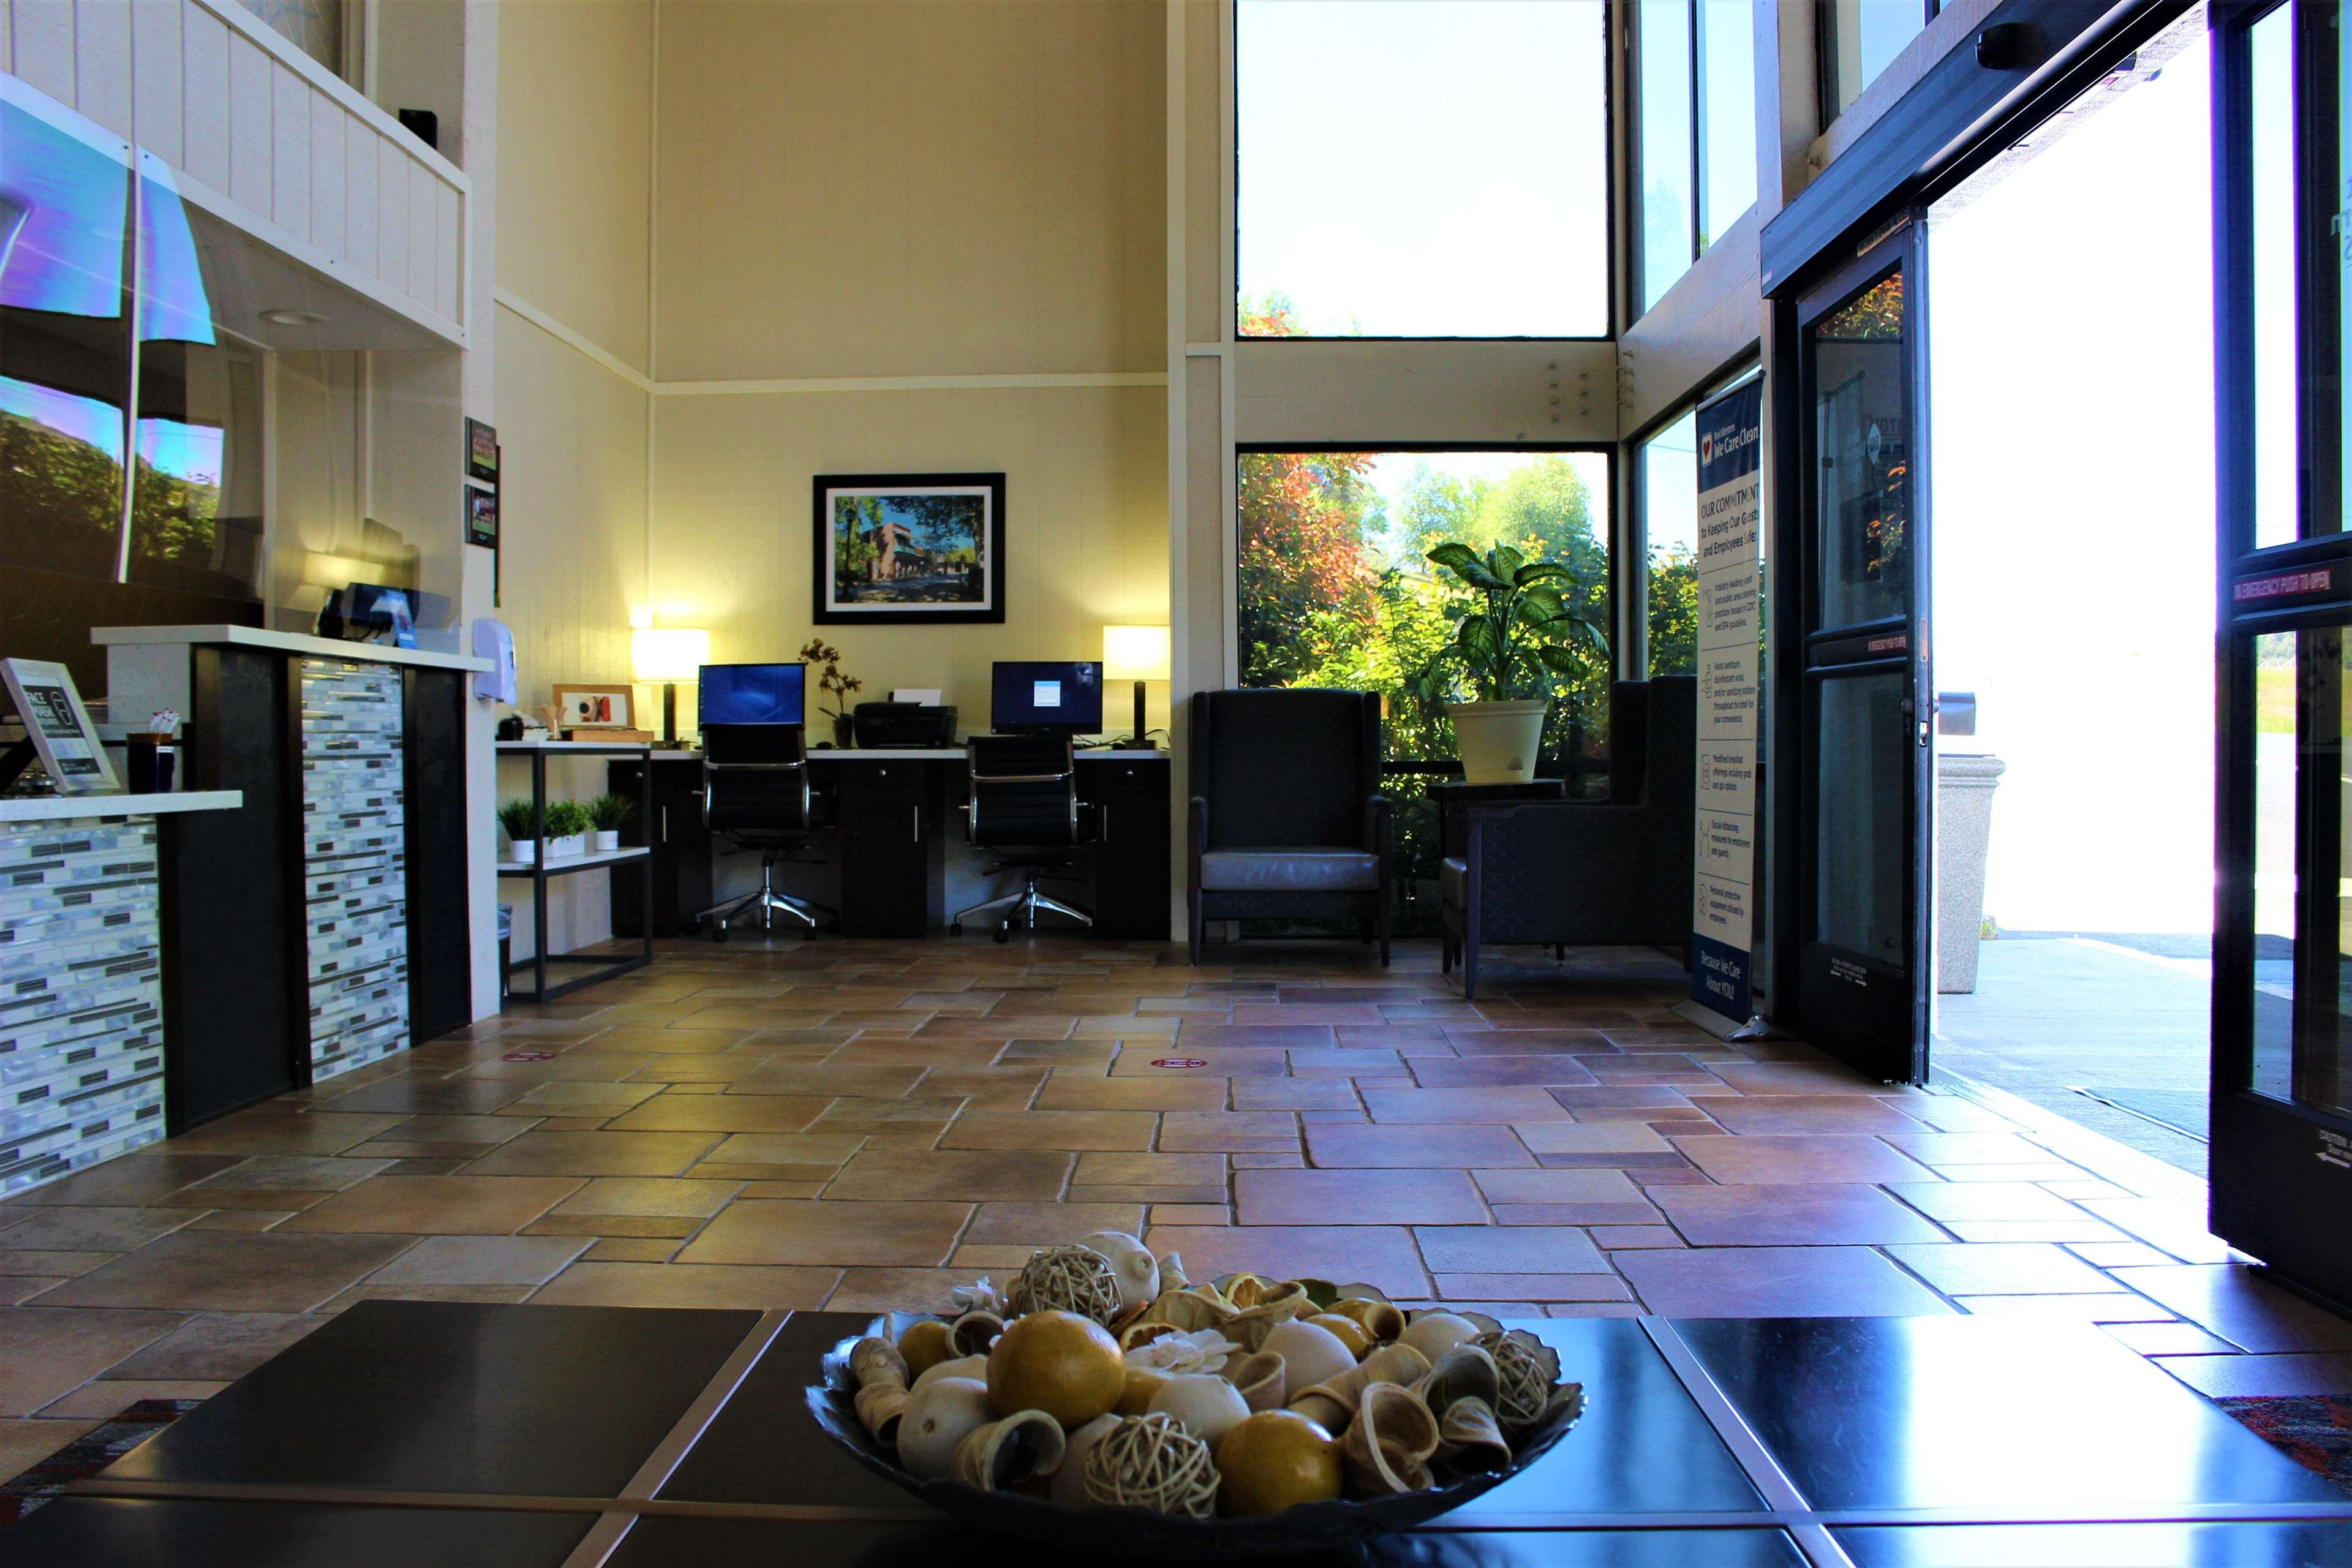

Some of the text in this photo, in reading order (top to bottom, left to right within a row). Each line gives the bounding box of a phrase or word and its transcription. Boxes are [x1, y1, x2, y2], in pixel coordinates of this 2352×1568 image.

[1714, 426, 1758, 459] We Care Clean
[1702, 484, 1758, 519] OUR COMMITMENT
[1702, 527, 1706, 538] to
[1708, 521, 1728, 537] Keeping
[1730, 516, 1740, 529] Our
[1703, 543, 1713, 557] and
[1714, 537, 1743, 554] Employees
[1701, 951, 1741, 980] Because We Care
